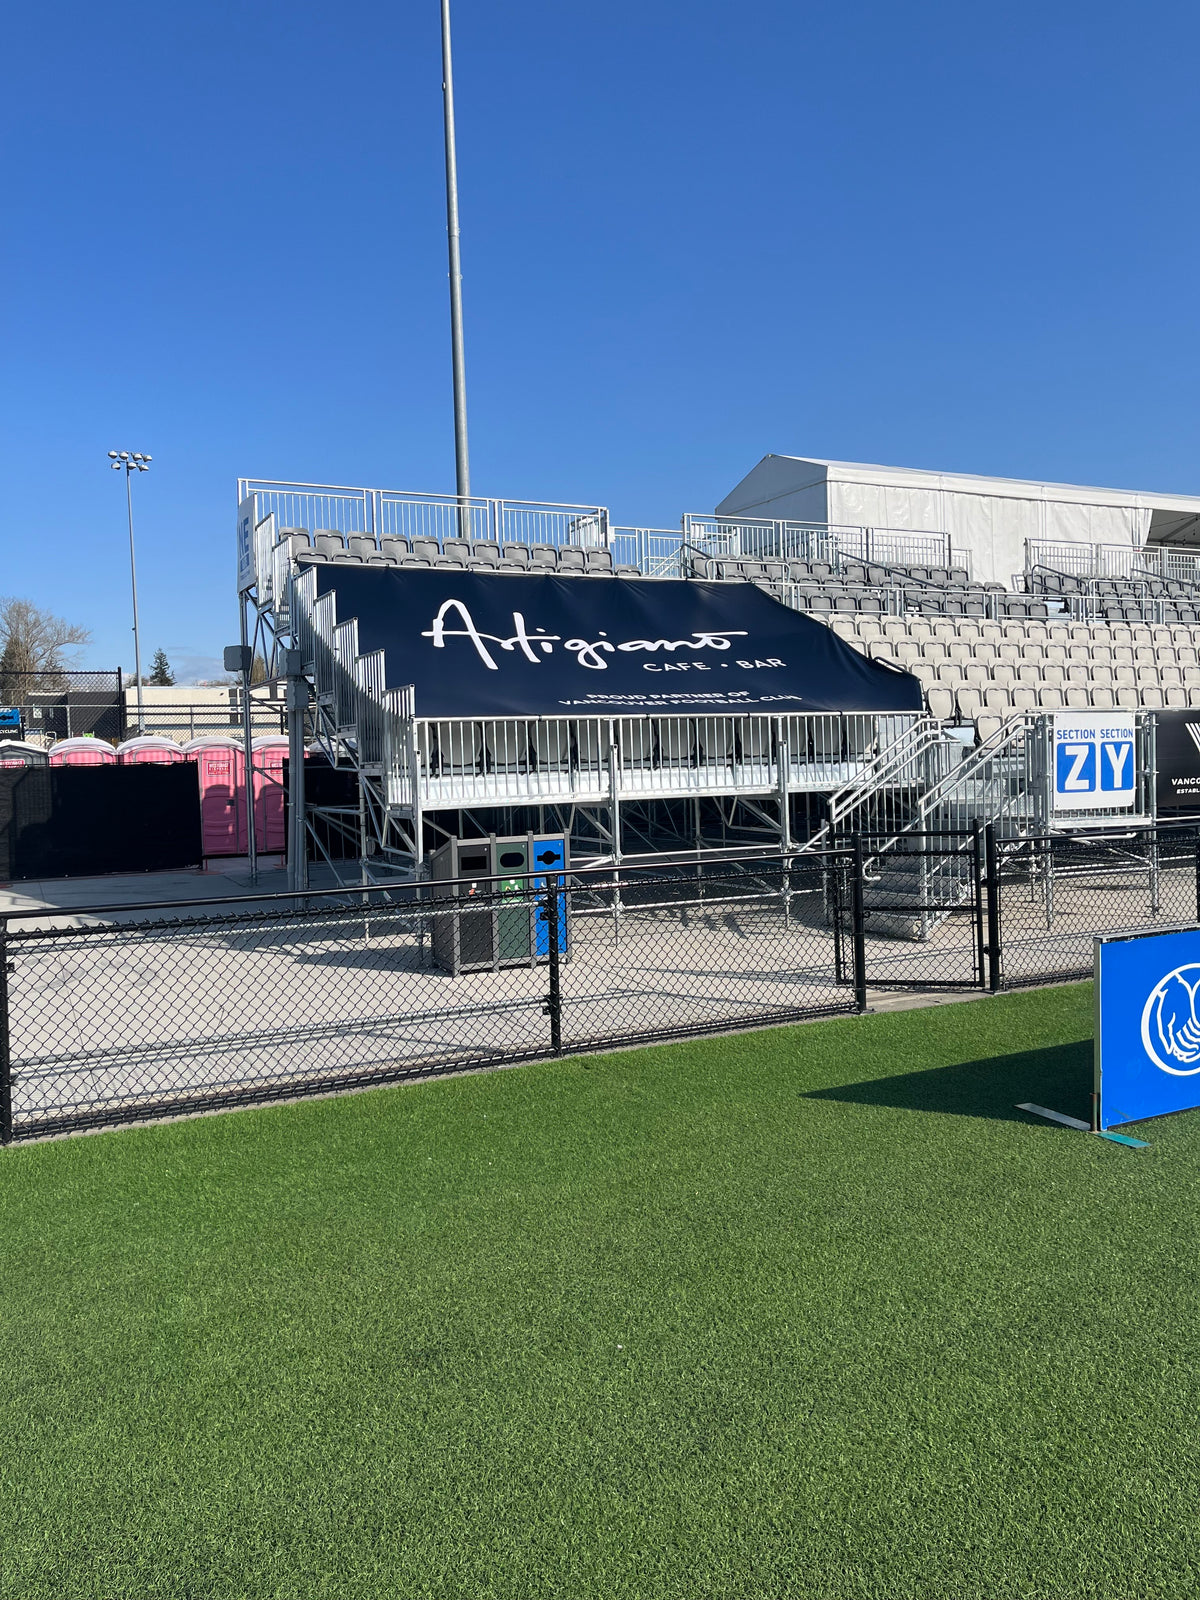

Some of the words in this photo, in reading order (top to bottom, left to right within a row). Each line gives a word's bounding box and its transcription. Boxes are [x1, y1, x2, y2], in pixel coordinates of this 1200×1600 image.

[421, 599, 748, 670] Artigiano
[643, 661, 711, 672] CAFE
[736, 658, 787, 669] BAR
[1056, 729, 1096, 740] SECTION
[1100, 728, 1134, 739] SECTION
[1065, 745, 1089, 790] Z
[1105, 744, 1130, 788] Y
